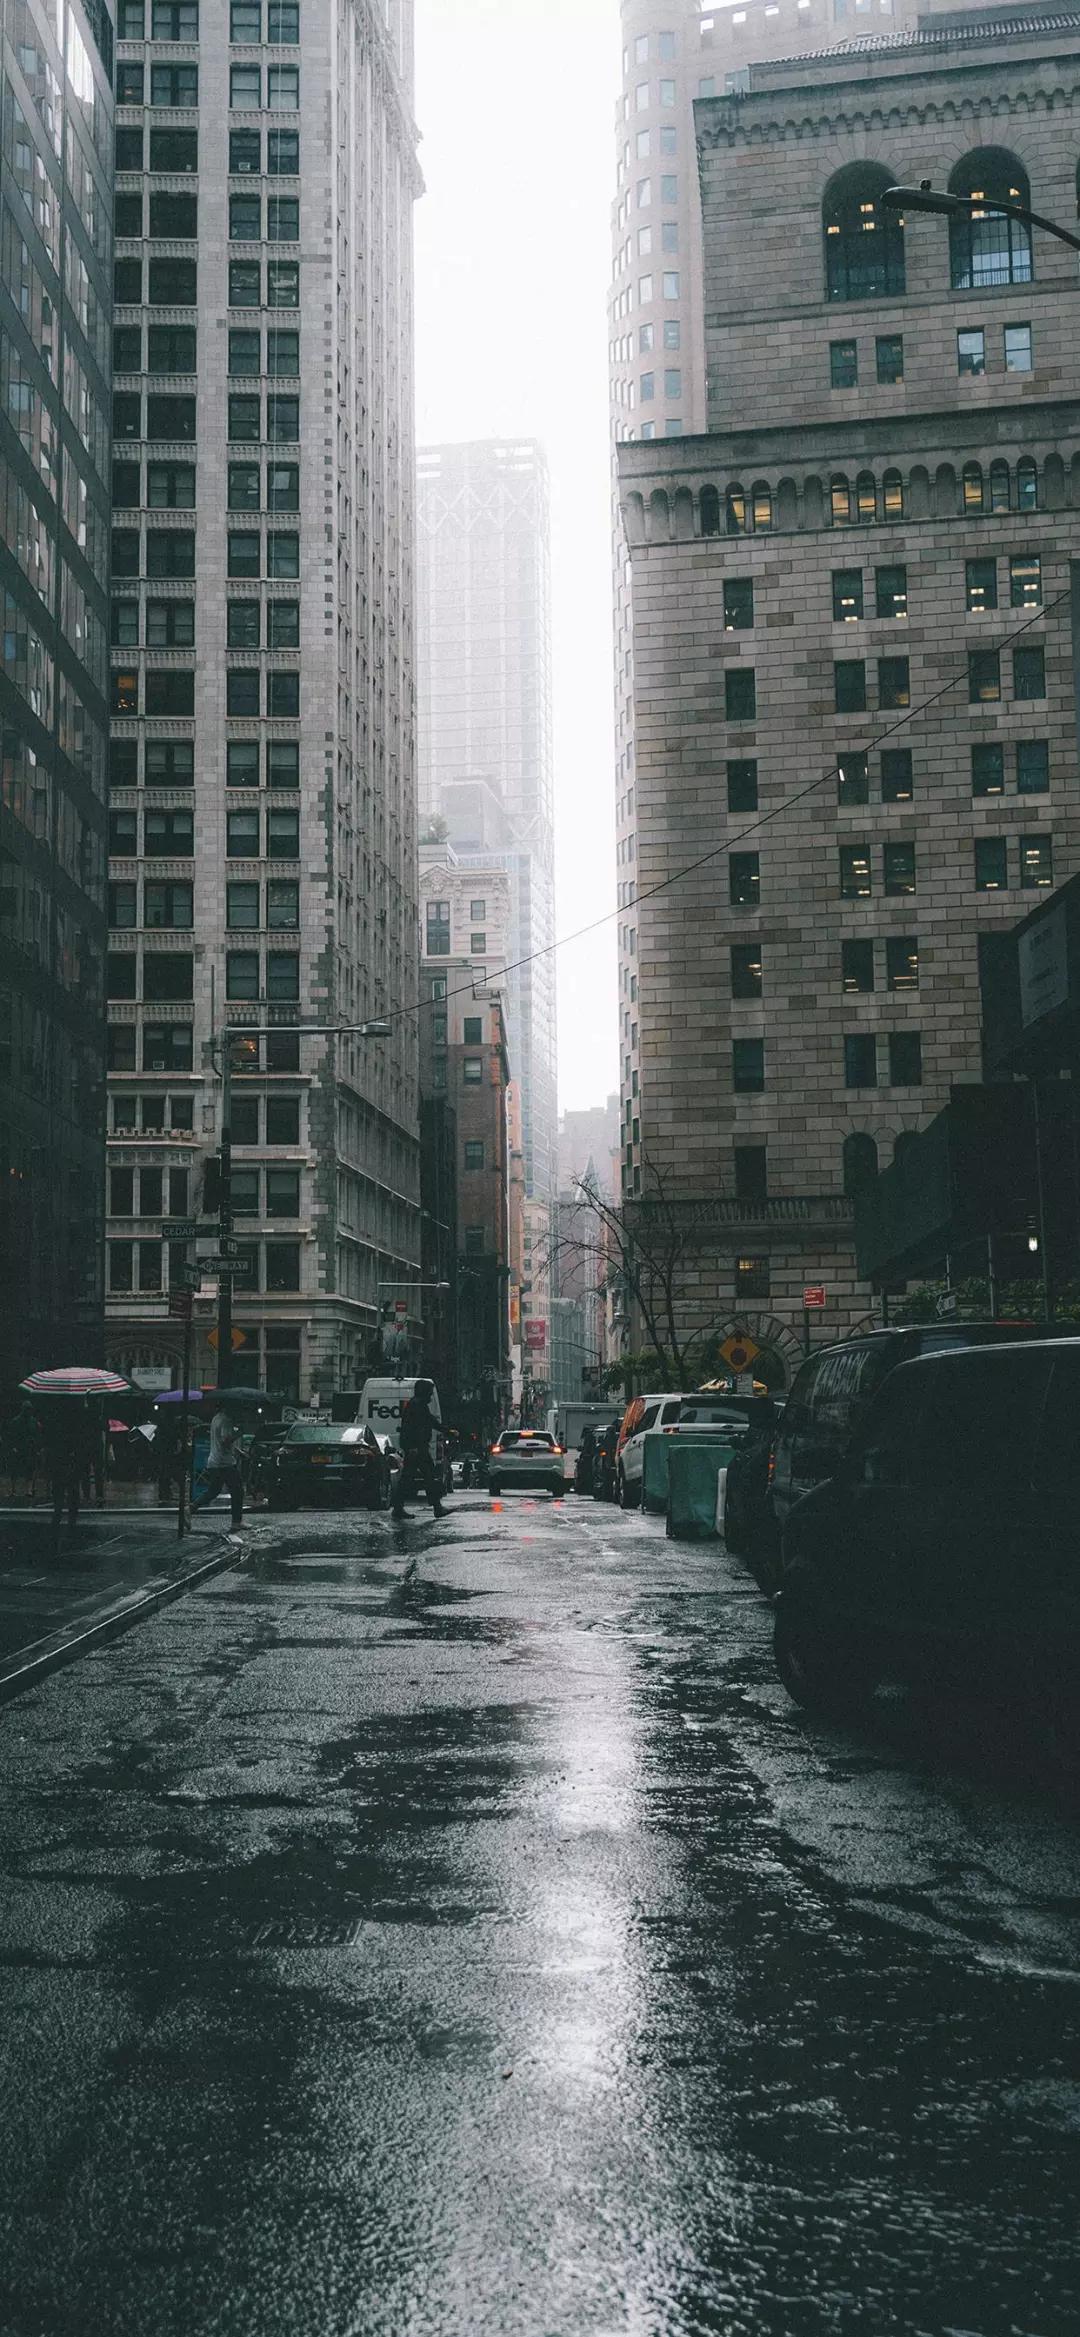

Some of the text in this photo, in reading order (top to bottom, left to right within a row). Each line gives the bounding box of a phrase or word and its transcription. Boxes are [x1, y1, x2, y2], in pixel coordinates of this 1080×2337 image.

[163, 1227, 195, 1236] CEDAR
[204, 1262, 245, 1270] ONE WAY
